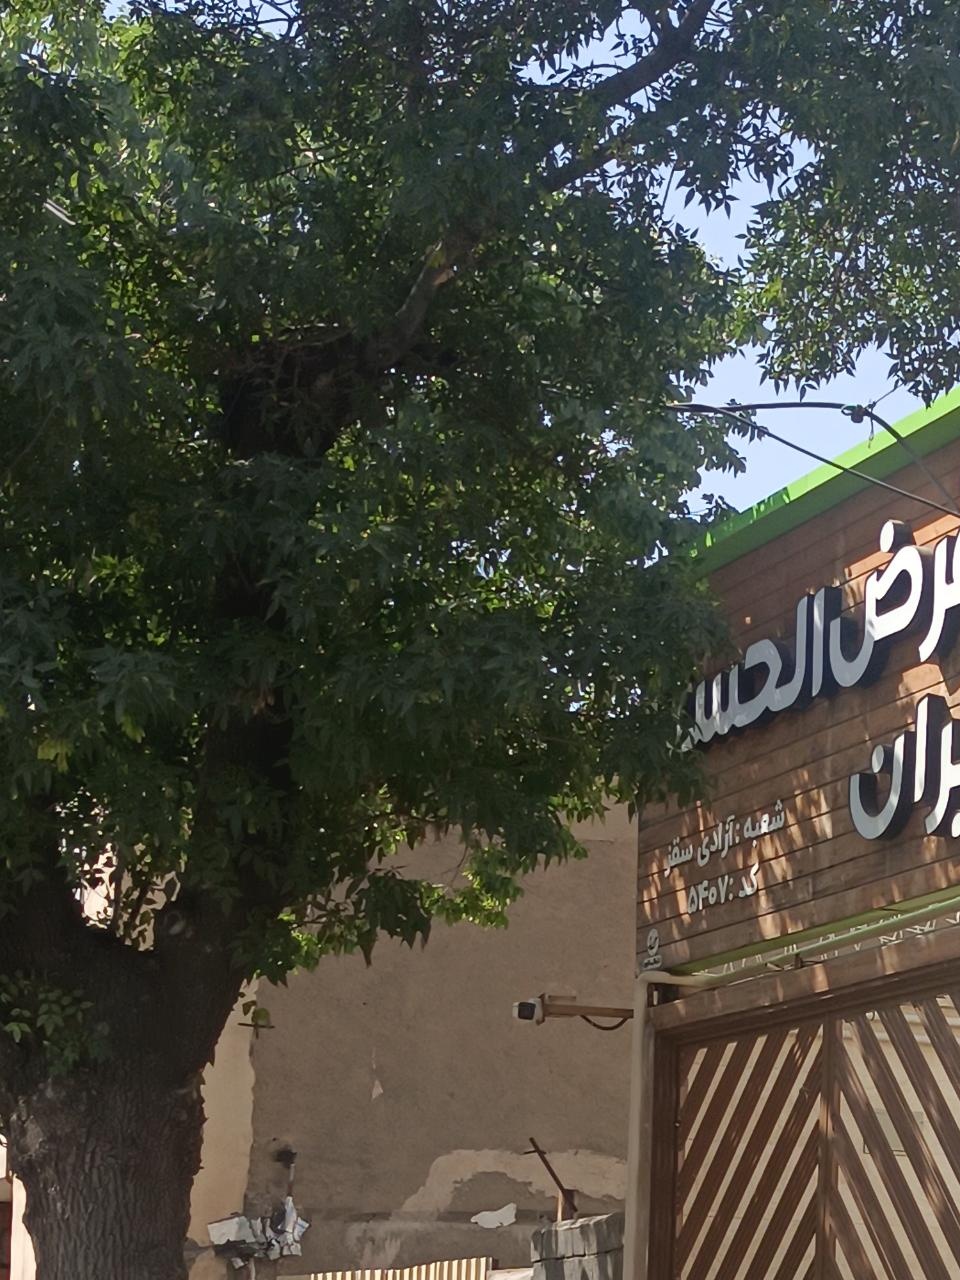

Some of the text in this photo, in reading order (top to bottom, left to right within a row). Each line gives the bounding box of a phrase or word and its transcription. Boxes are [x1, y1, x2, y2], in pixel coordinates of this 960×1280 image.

[743, 799, 786, 848] شعبه
[663, 836, 693, 879] سقز
[738, 860, 760, 898] کد
